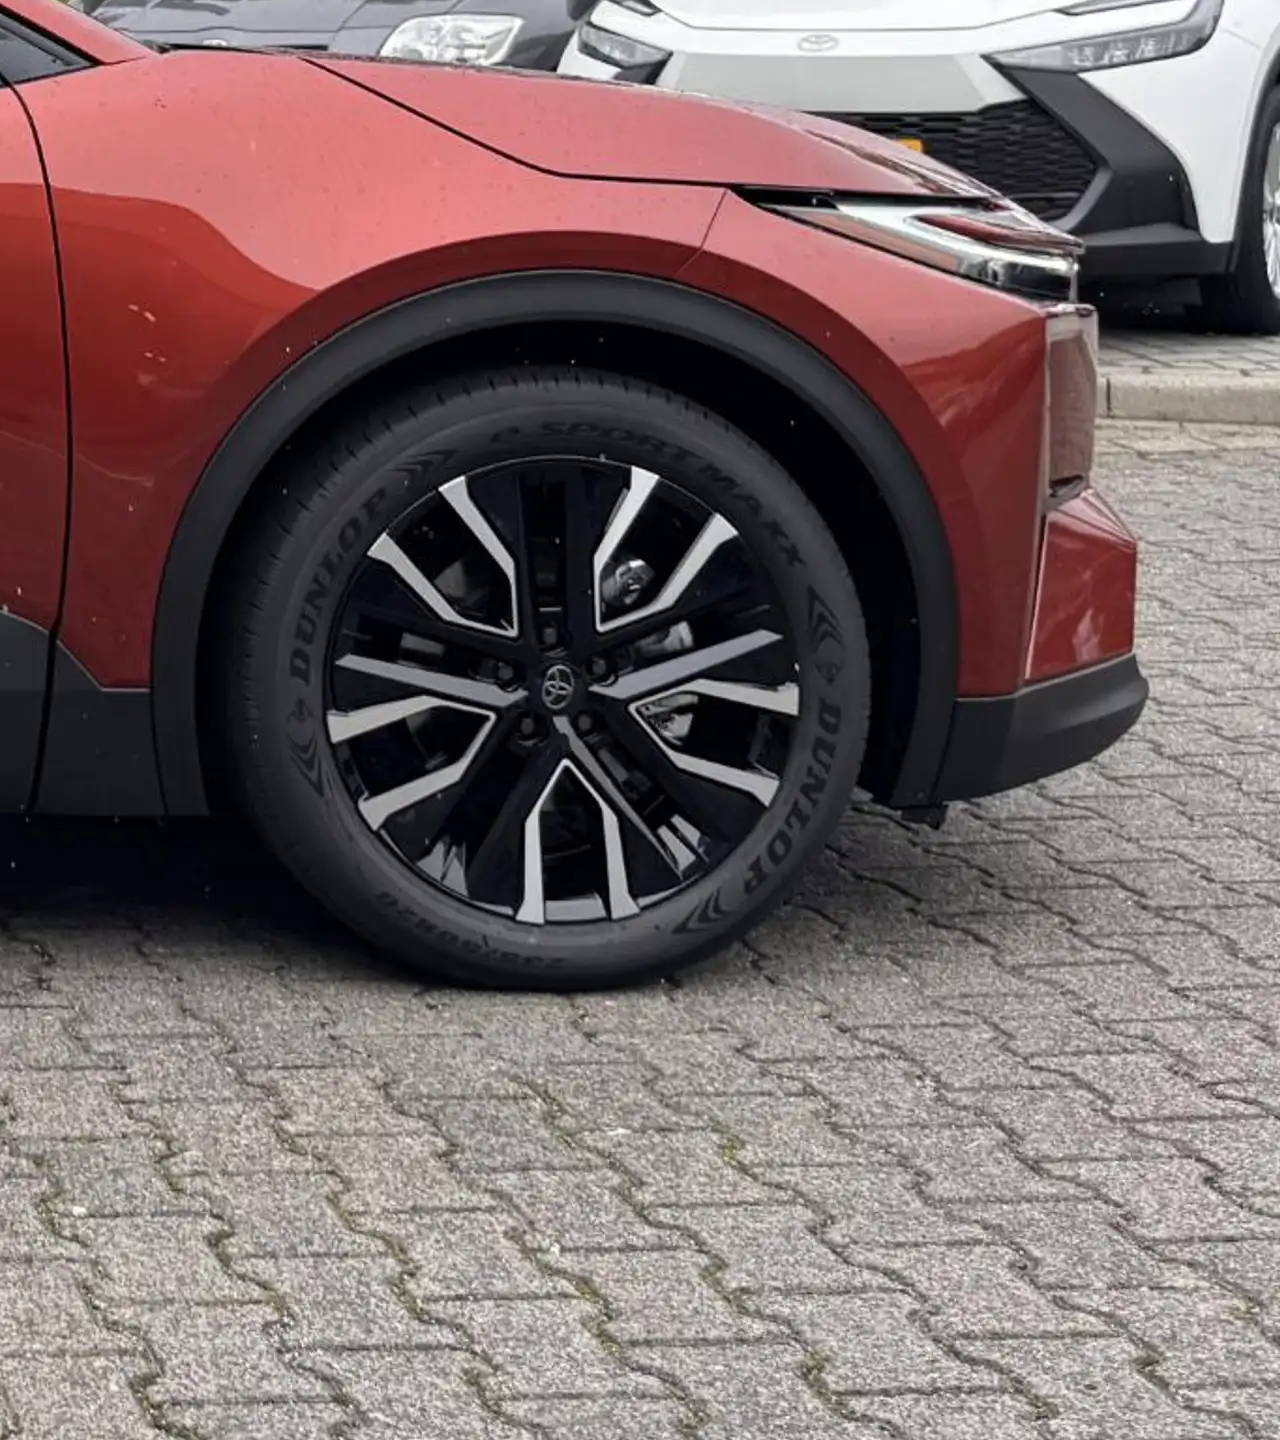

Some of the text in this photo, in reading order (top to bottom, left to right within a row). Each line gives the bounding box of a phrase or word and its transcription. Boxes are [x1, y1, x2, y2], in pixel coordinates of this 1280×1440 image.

[291, 488, 388, 688] DUNLOP
[698, 463, 806, 568] MAXX
[742, 701, 844, 899] DUNLOP
